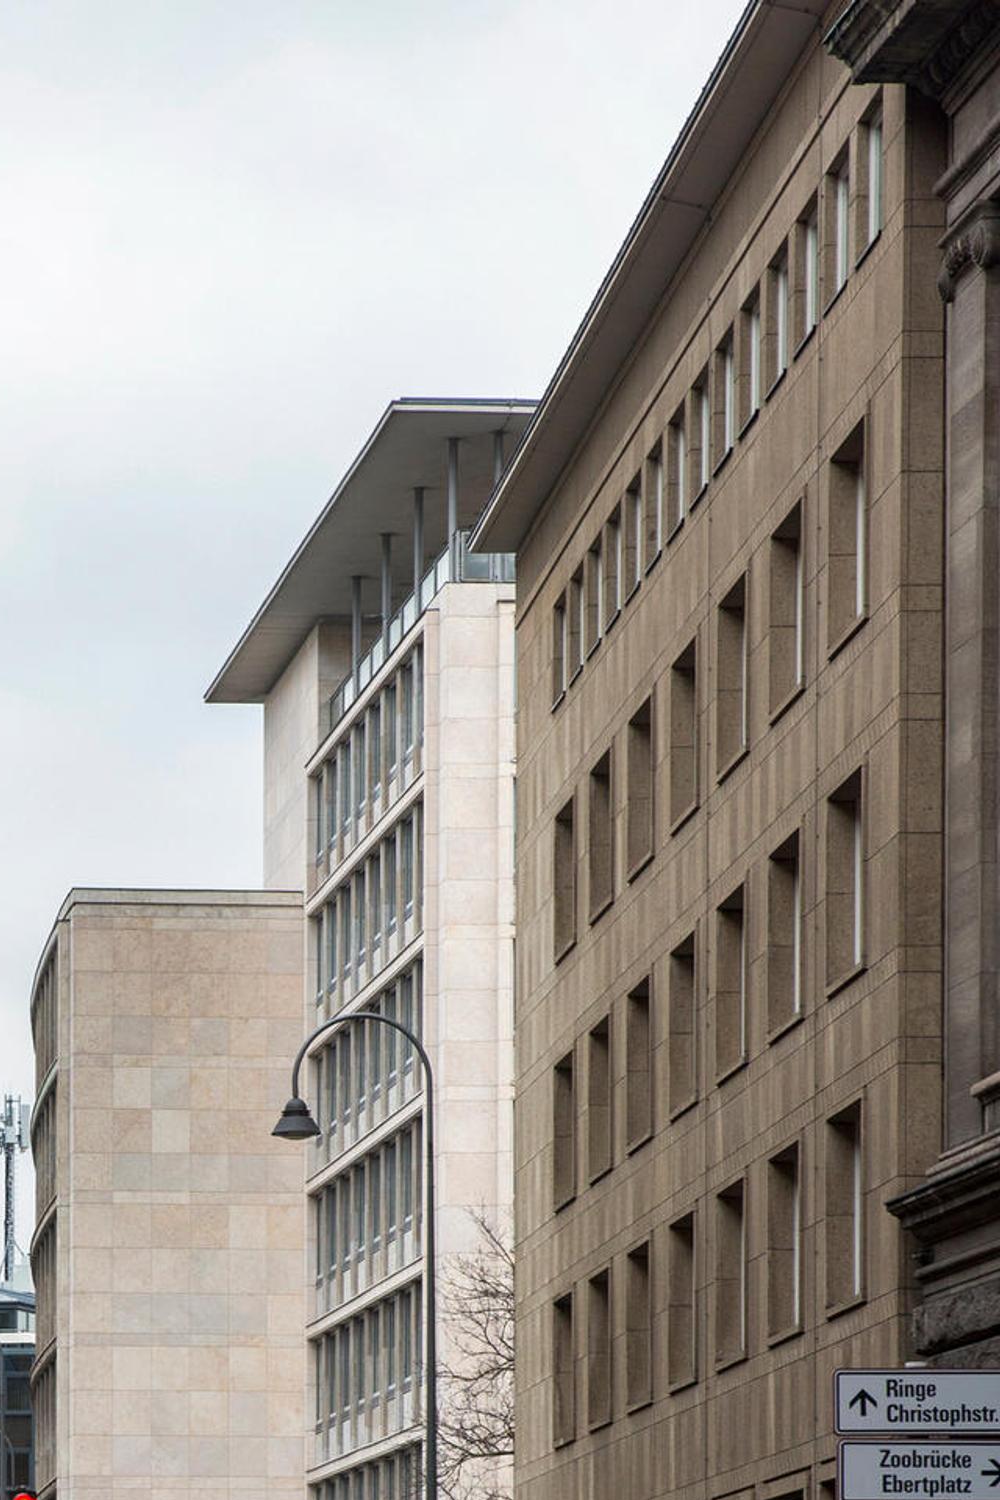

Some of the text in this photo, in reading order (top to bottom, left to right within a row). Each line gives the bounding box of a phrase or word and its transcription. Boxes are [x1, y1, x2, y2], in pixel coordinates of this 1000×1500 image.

[886, 1379, 937, 1401] Ringe
[887, 1404, 999, 1426] Christophstr.
[880, 1449, 972, 1469] Zoobrücke
[883, 1475, 972, 1498] Ebertplatz
